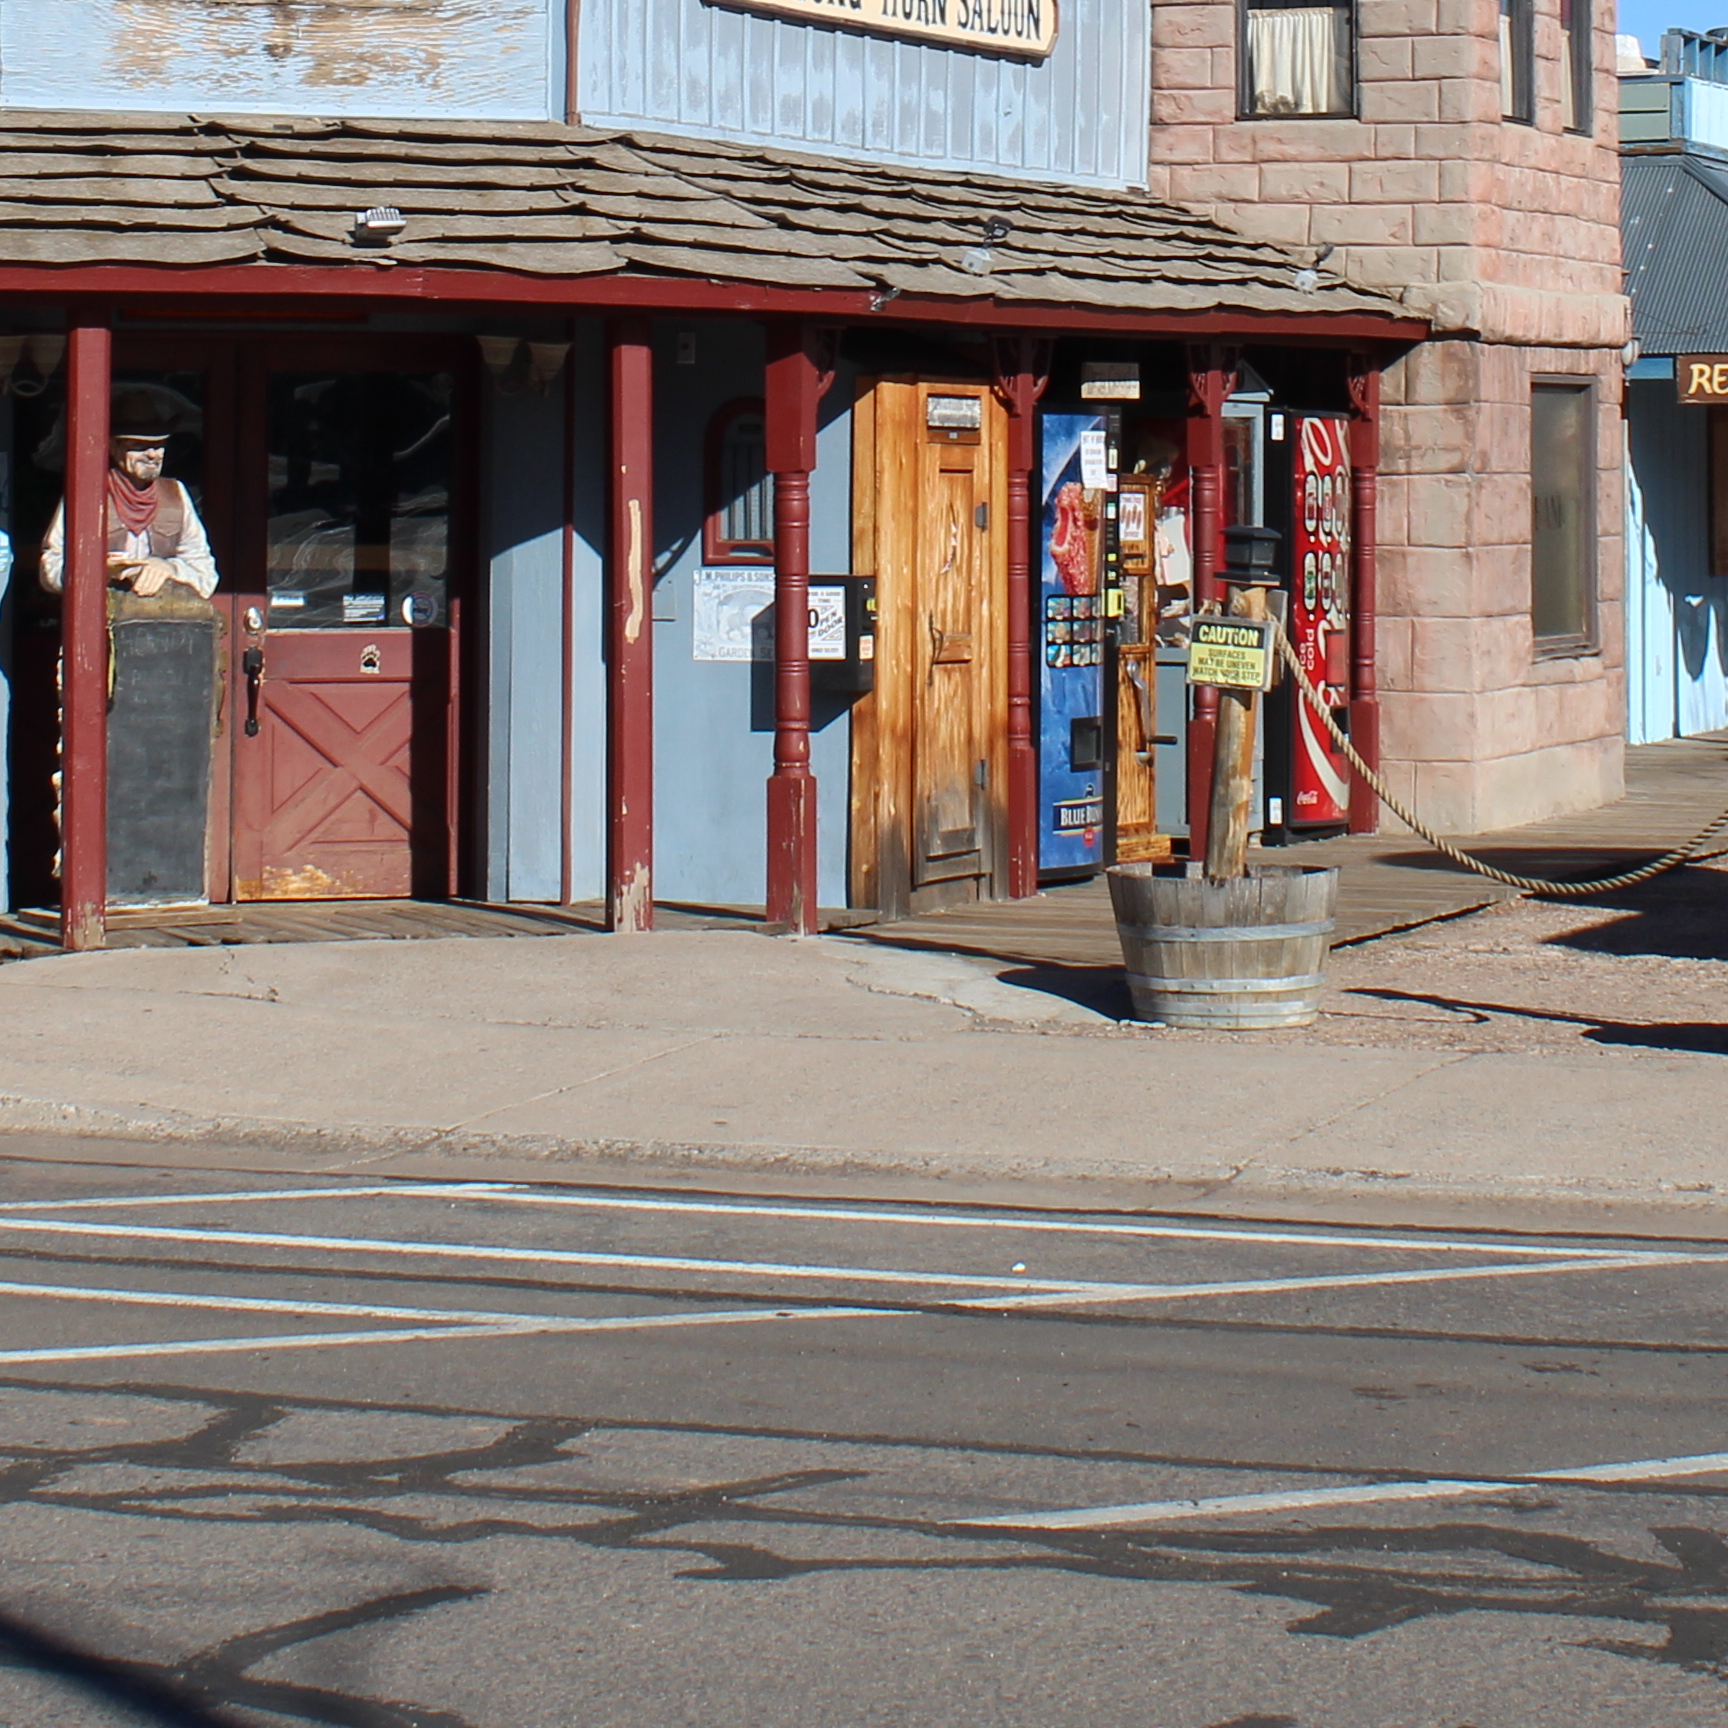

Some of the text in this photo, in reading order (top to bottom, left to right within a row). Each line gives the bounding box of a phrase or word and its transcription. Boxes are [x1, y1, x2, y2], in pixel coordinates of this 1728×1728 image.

[1198, 624, 1259, 647] CAUTION
[1208, 648, 1247, 660] SURFACES
[1299, 642, 1307, 670] ce
[1305, 628, 1315, 671] cold
[1192, 666, 1218, 677] WATCH
[1197, 657, 1255, 670] MAY BE UNEVEN
[1060, 807, 1086, 827] BLUE
